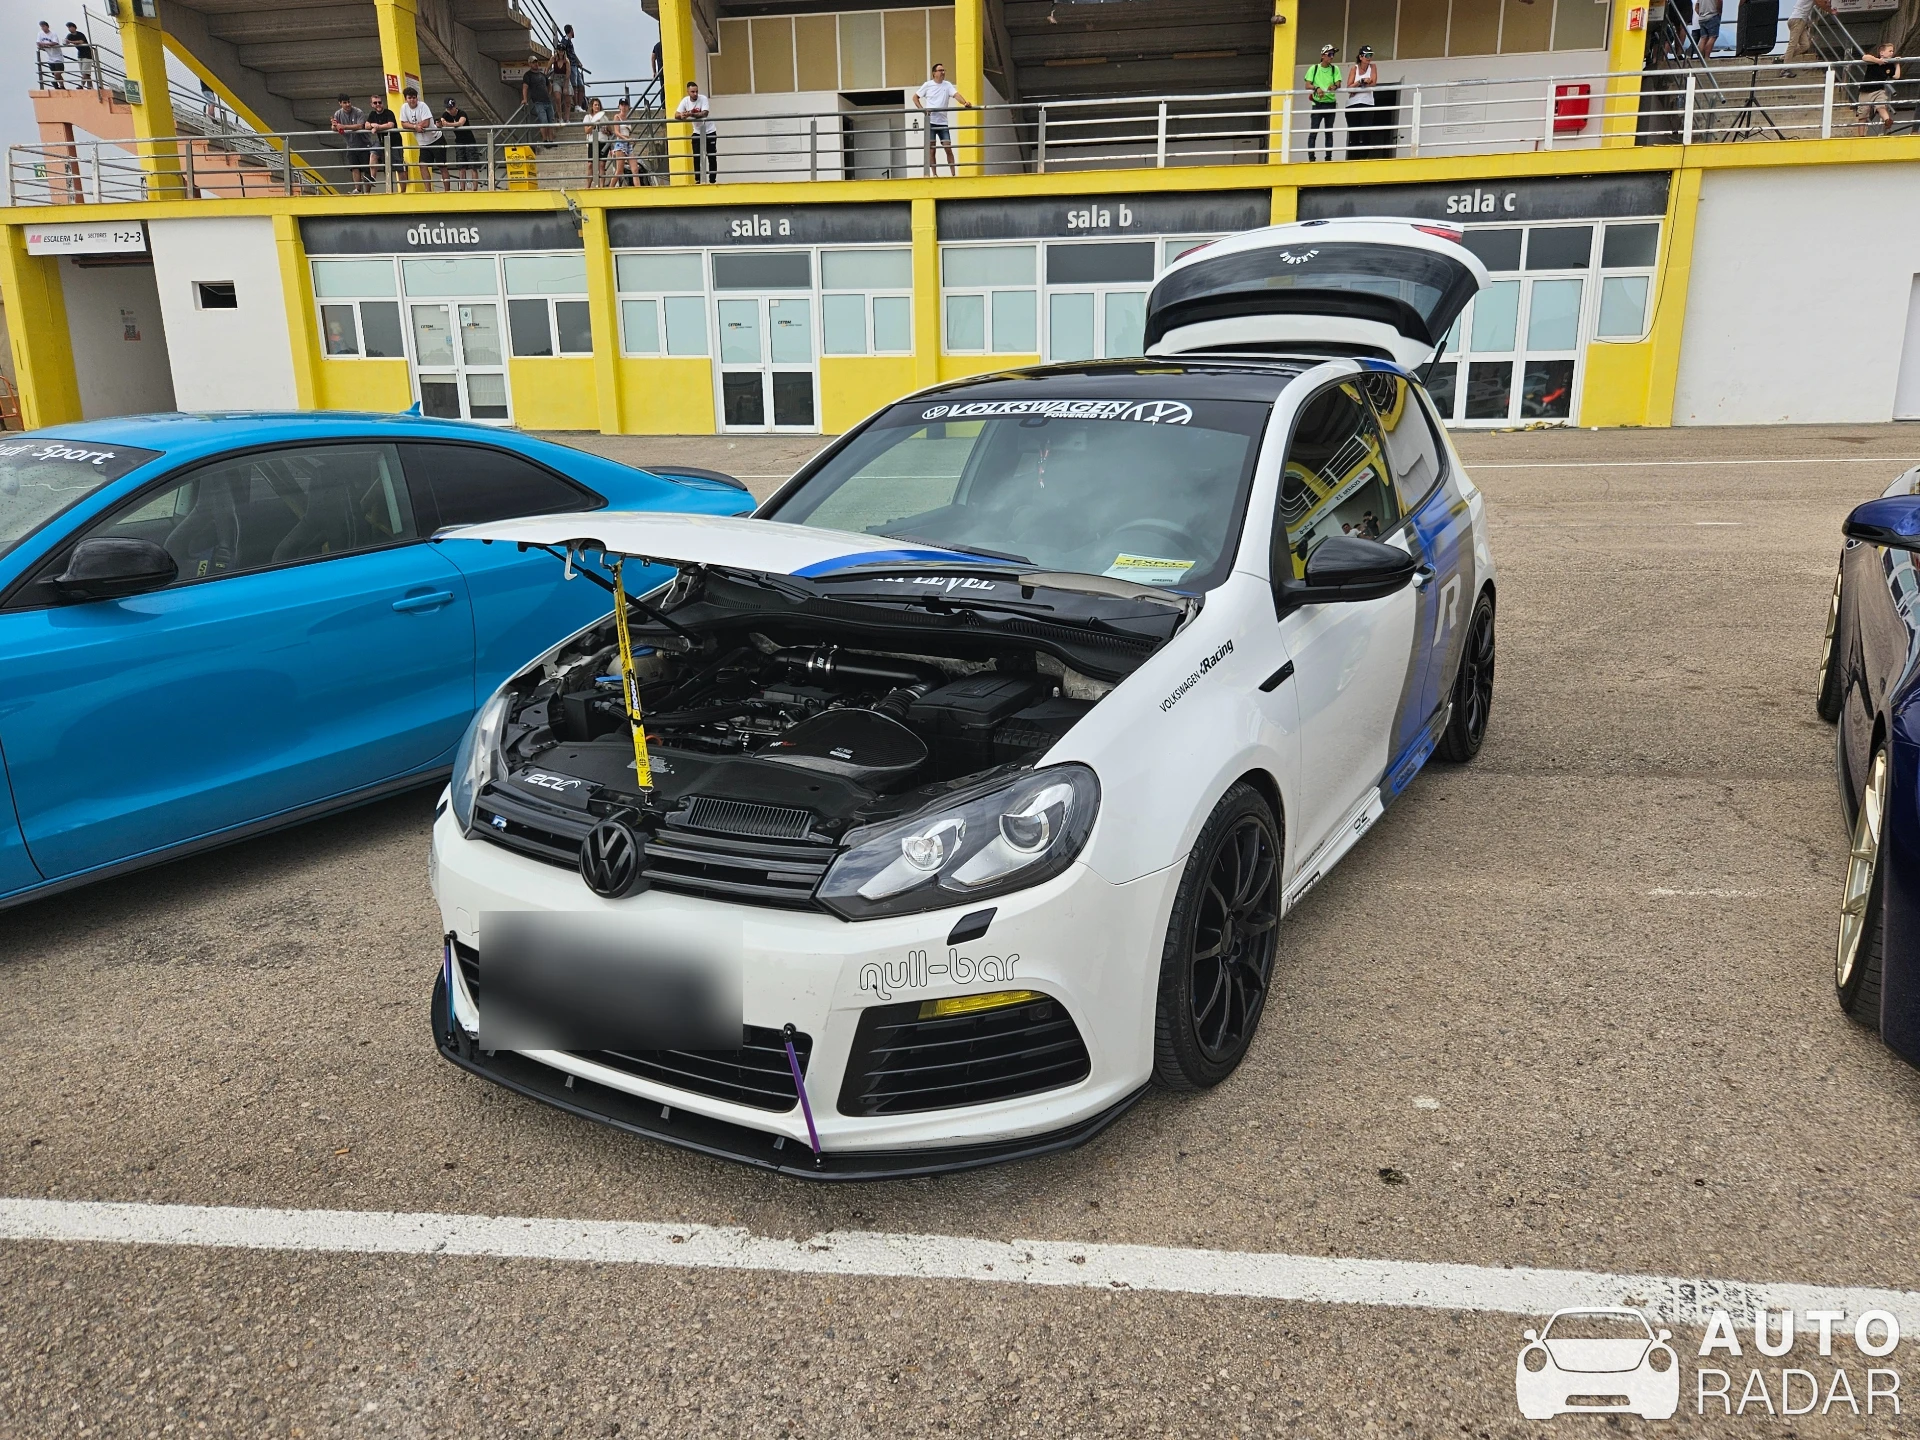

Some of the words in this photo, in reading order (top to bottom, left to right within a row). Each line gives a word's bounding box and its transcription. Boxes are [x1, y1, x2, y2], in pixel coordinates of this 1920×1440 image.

[1446, 188, 1495, 214] sala
[1503, 192, 1516, 212] c
[731, 214, 772, 237] sala
[778, 218, 791, 236] a
[1067, 204, 1110, 229] sala
[1118, 203, 1133, 227] b
[43, 234, 71, 243] ESCALERA
[73, 233, 84, 242] 14
[113, 231, 141, 243] 1-2-3
[407, 221, 480, 245] oficinas
[947, 400, 1133, 417] VOLKSWAGEN
[1043, 412, 1098, 420] POWERED
[1100, 412, 1118, 420] BY
[32, 444, 116, 465] Sport
[1159, 670, 1201, 713] VOLKSWAGEN
[1200, 639, 1234, 675] Racing
[859, 948, 1020, 1001] null-bar
